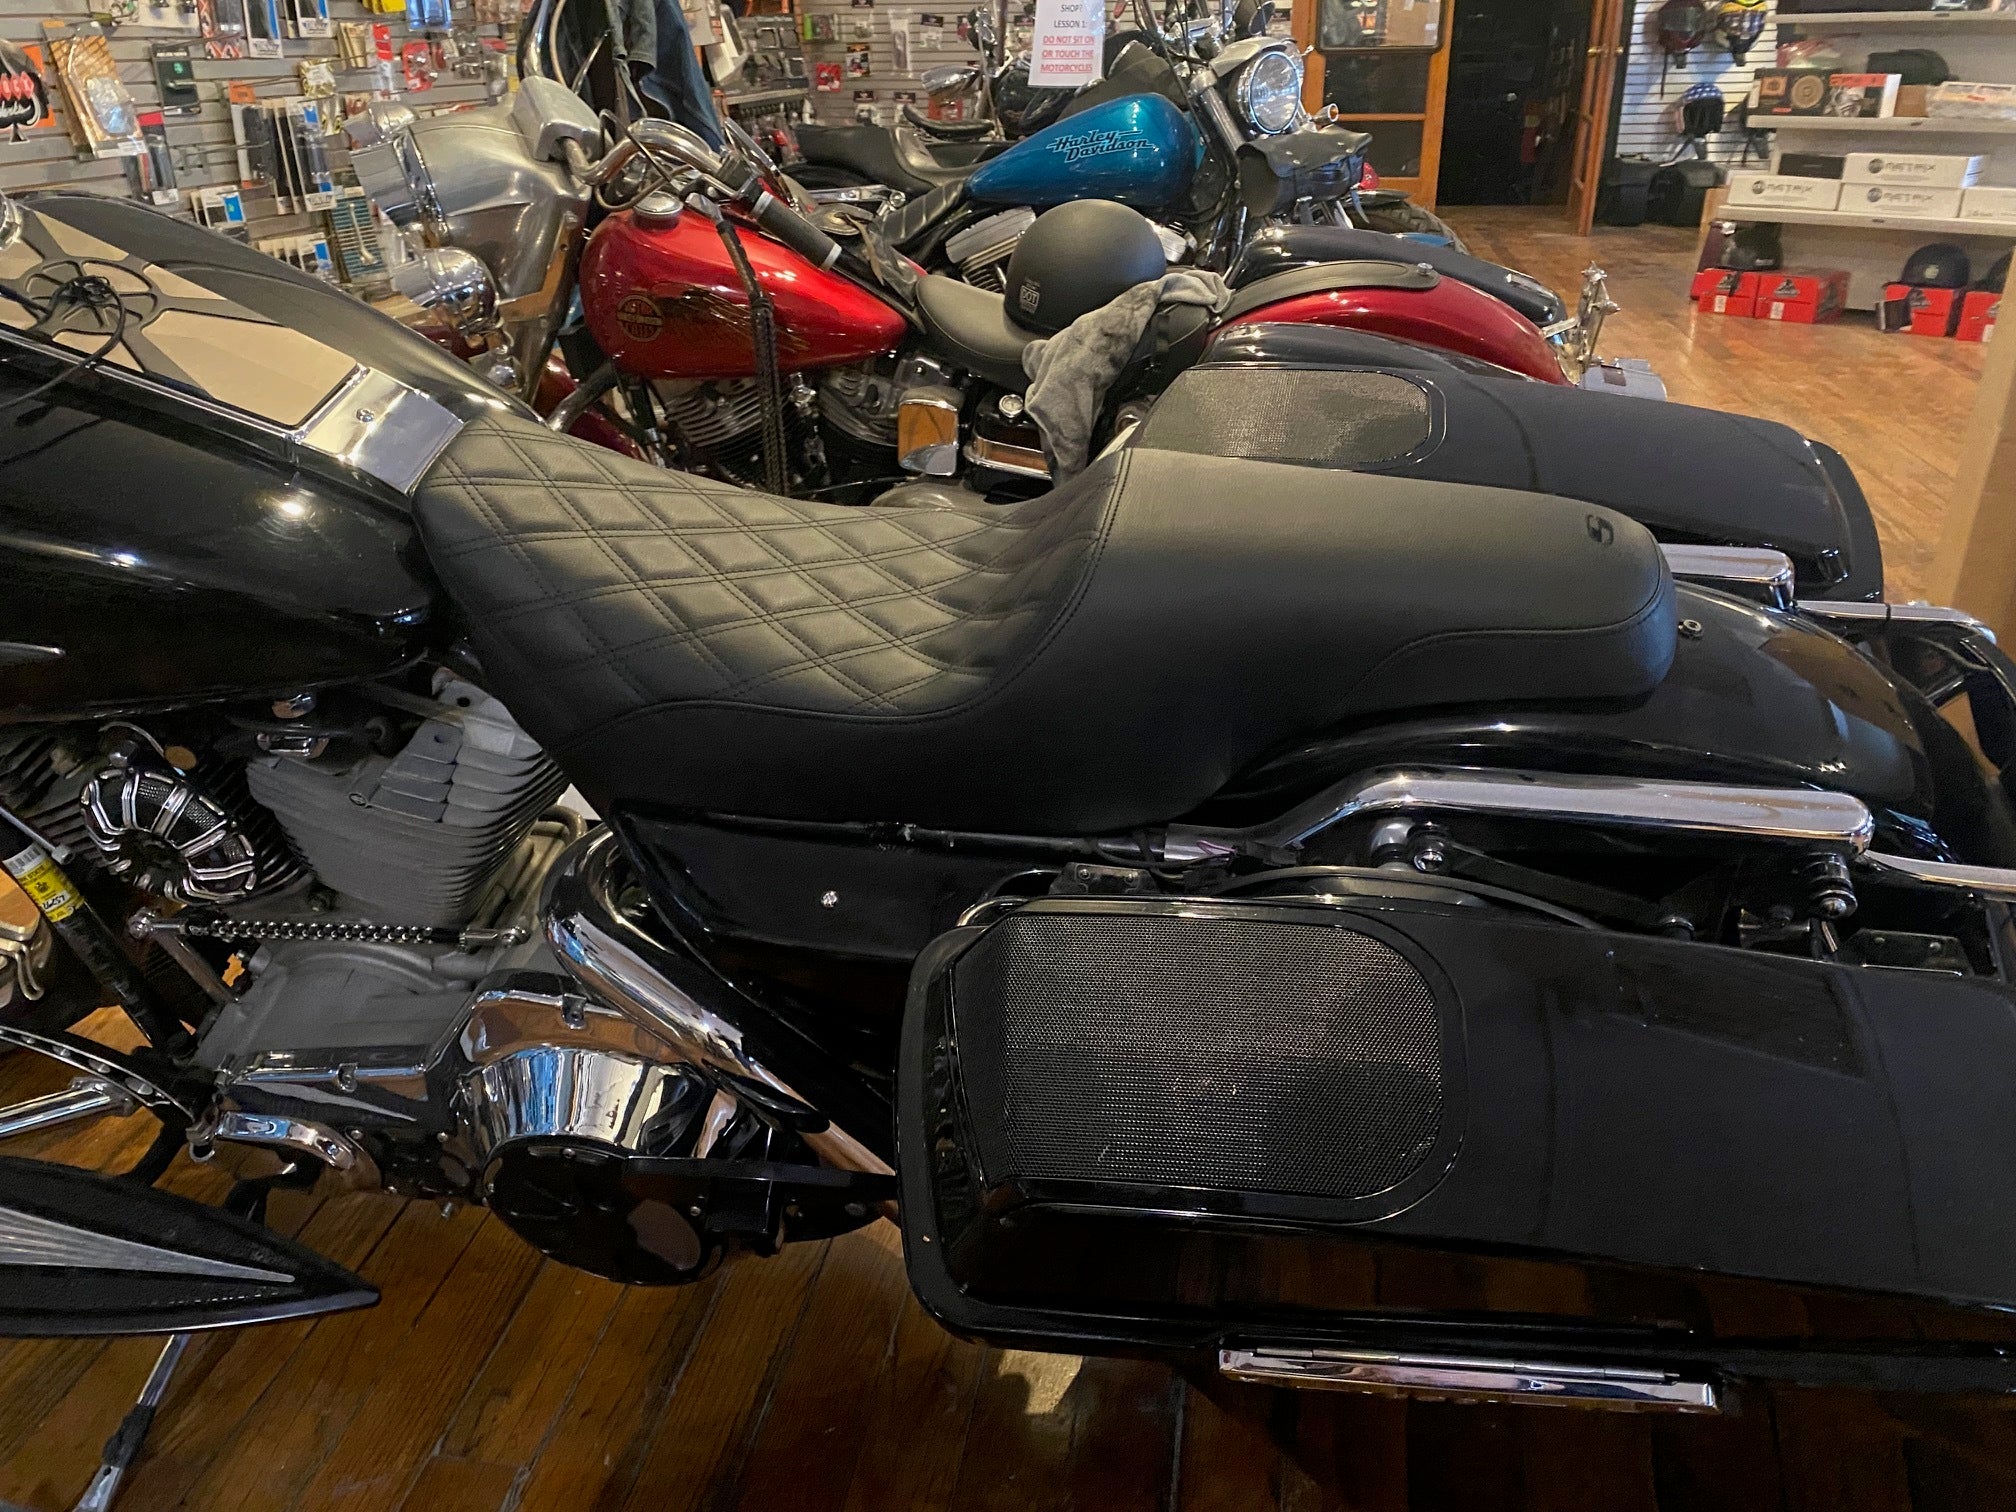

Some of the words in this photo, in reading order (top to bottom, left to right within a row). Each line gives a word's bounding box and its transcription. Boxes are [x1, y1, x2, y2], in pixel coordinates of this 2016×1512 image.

[1053, 20, 1080, 28] LESSON
[1042, 35, 1055, 44] DO
[1056, 35, 1072, 44] NOT
[1073, 35, 1083, 44] SIT
[1084, 35, 1095, 44] ON
[1041, 49, 1053, 58] OR
[1055, 49, 1080, 58] TOUCH
[1081, 49, 1094, 58] THE
[1040, 63, 1093, 73] MOTORCYCLES
[1046, 129, 1143, 153] Harley
[1064, 138, 1155, 163] Davidson
